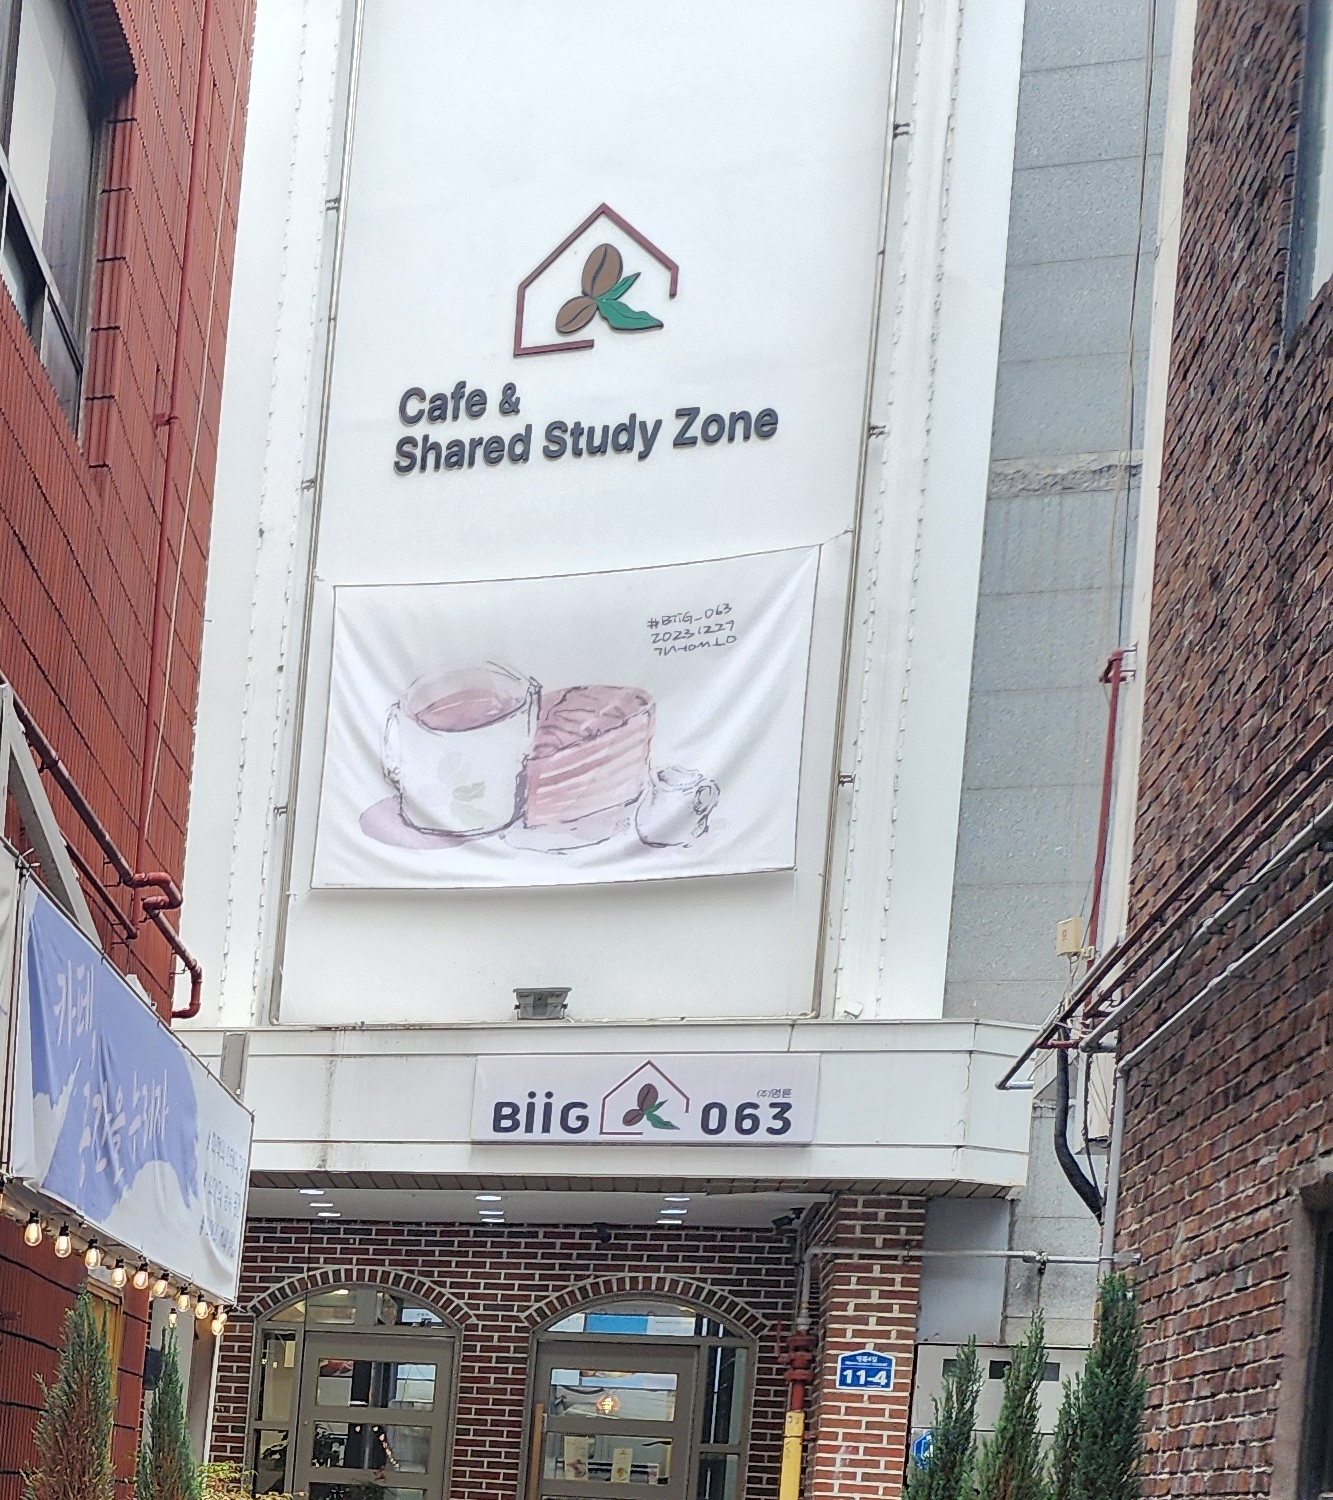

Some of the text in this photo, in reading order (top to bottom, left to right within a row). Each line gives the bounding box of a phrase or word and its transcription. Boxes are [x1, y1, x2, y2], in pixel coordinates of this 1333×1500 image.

[399, 380, 521, 426] Cafe &
[393, 406, 780, 475] Shared Study Zone
[492, 1090, 793, 1136] BiiG 063
[842, 1369, 888, 1386] 11-4
